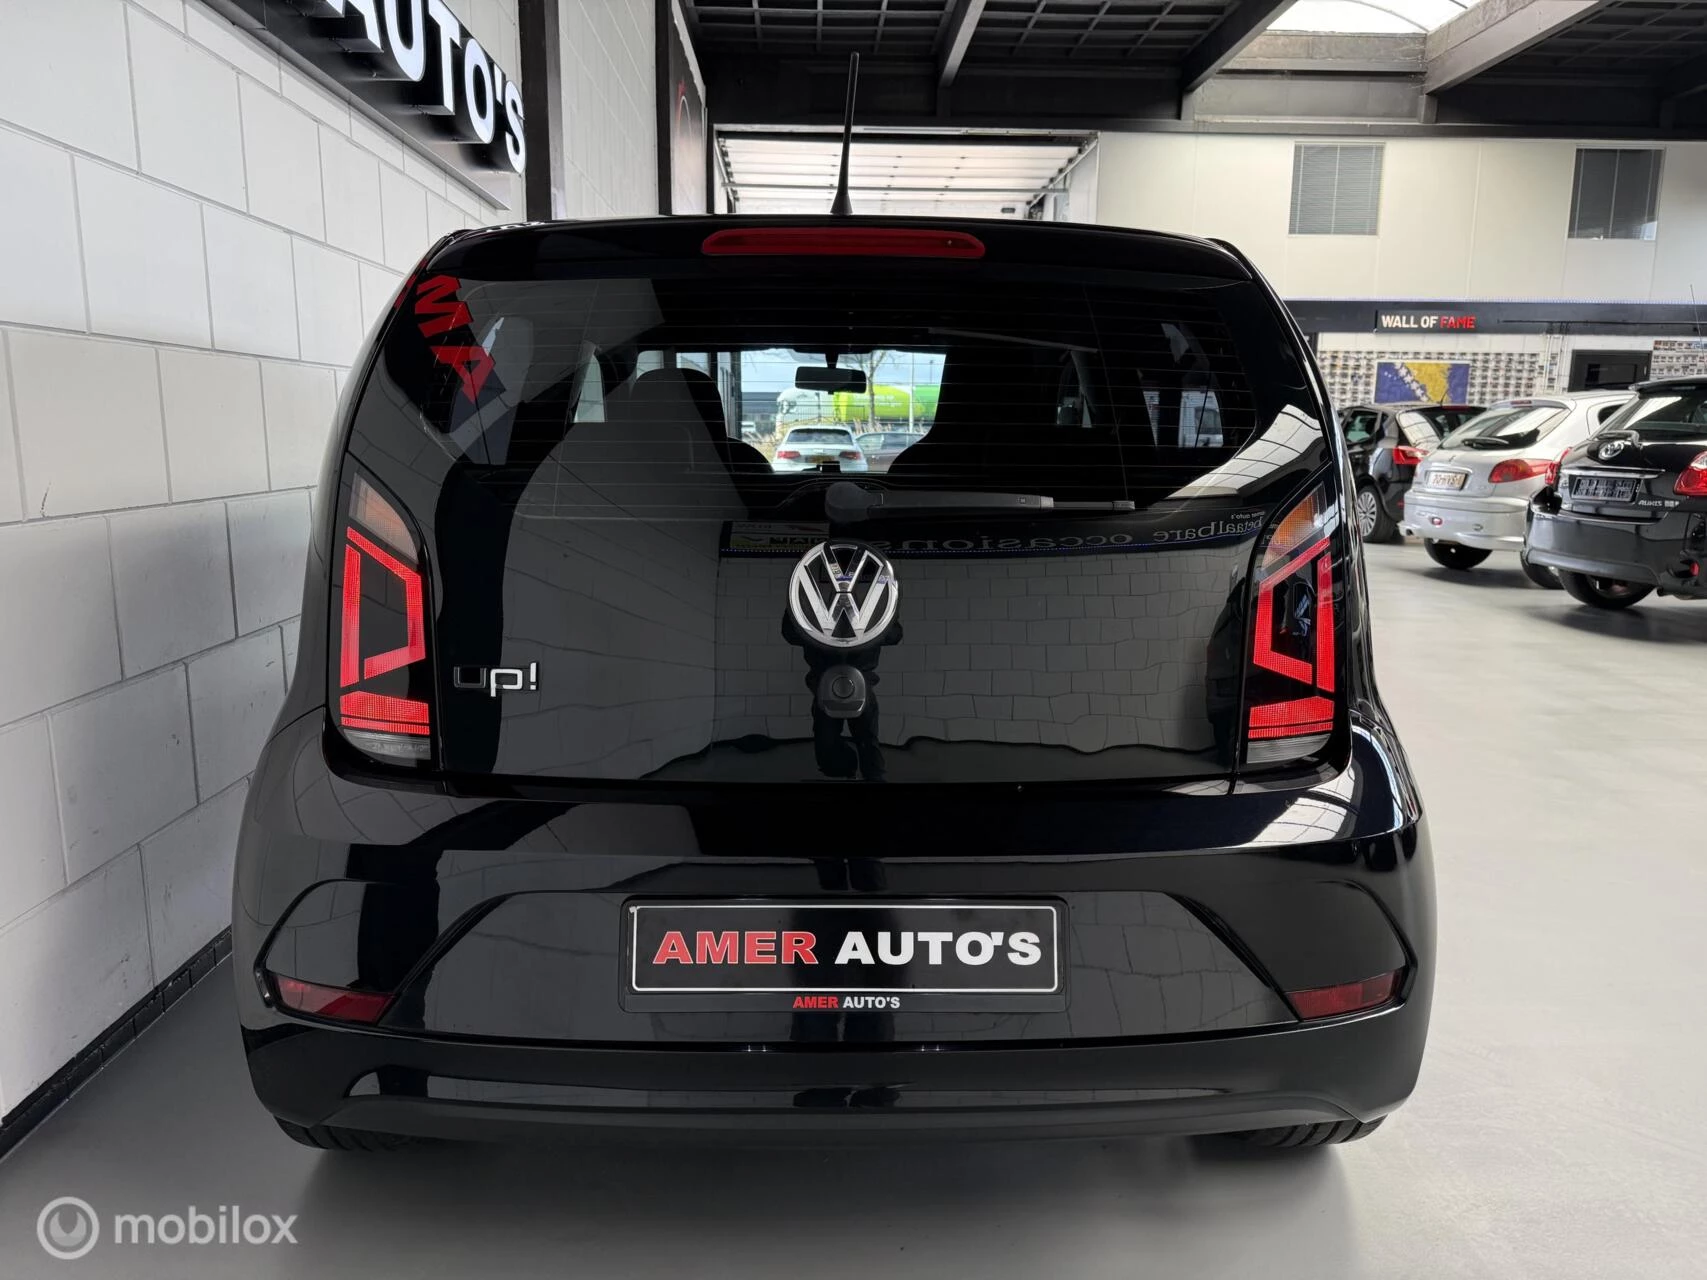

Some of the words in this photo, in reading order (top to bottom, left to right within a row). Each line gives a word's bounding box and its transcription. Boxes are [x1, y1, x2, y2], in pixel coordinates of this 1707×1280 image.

[1381, 315, 1418, 328] WALL
[1421, 315, 1439, 328] OF
[1440, 315, 1476, 329] FAME
[453, 662, 537, 697] up!
[652, 930, 818, 965] AMER
[834, 931, 1042, 965] AUTO'S
[792, 996, 838, 1009] AMER
[843, 996, 900, 1009] AUTO'S
